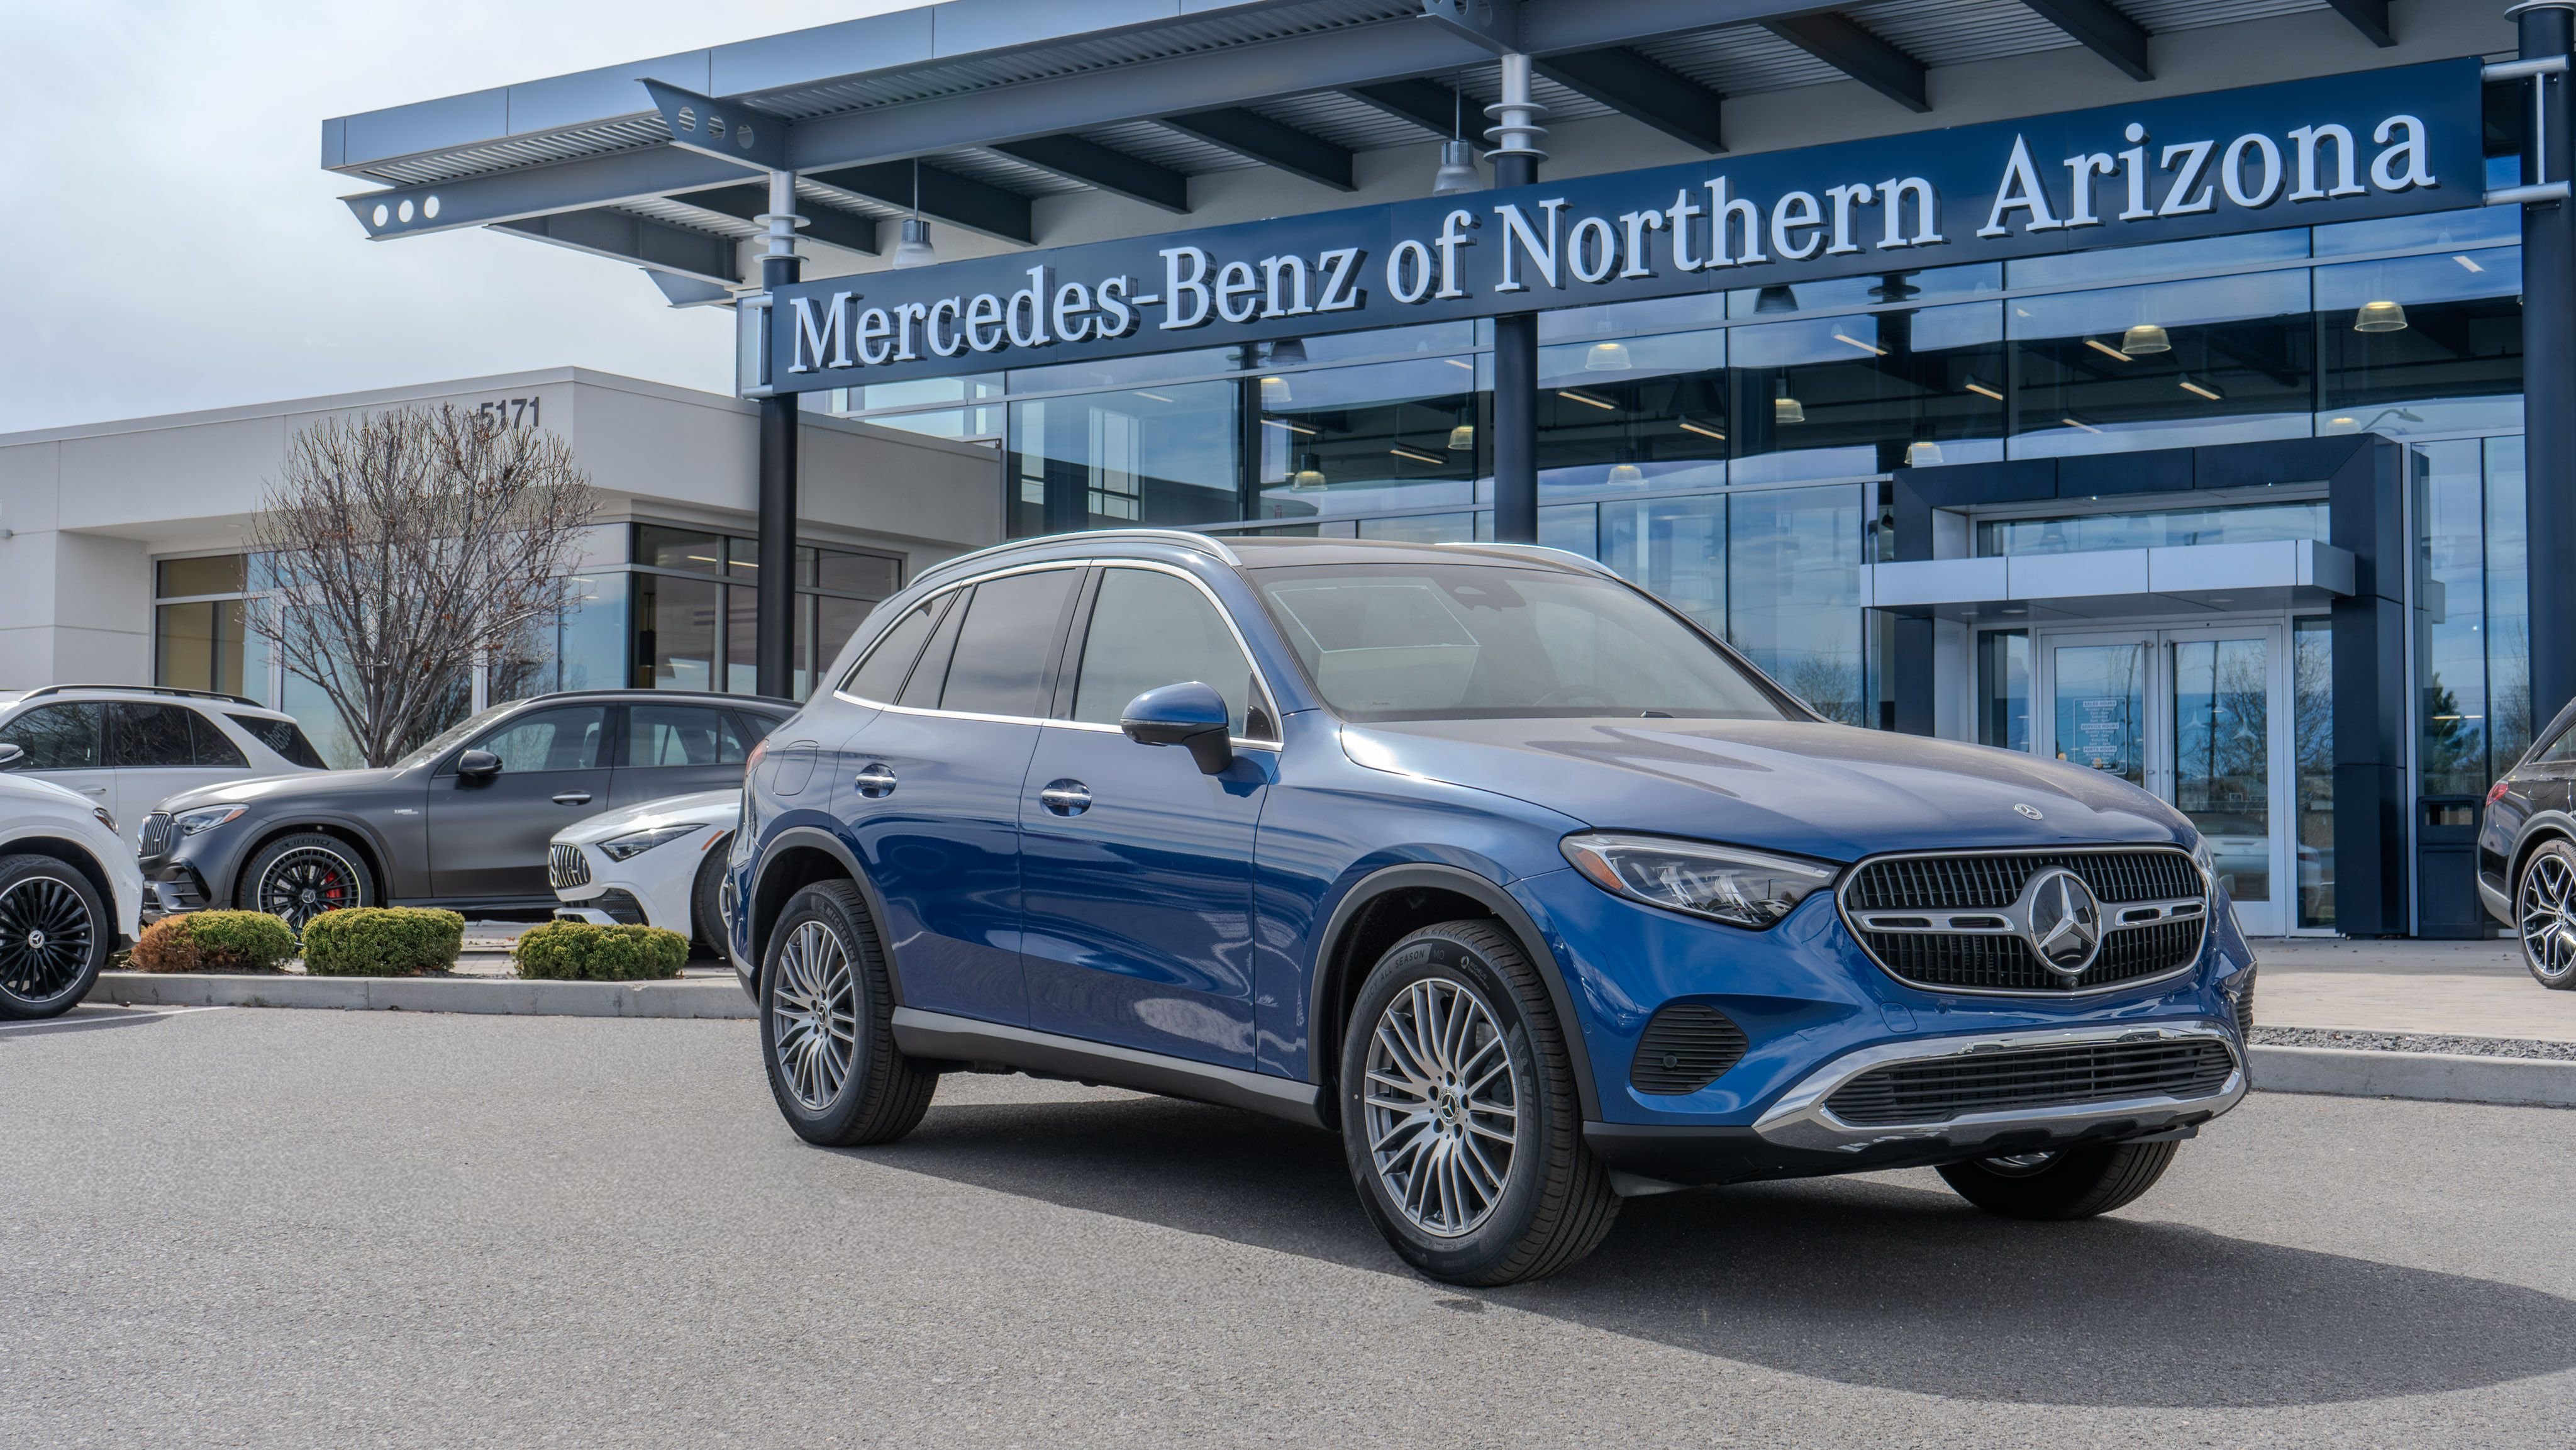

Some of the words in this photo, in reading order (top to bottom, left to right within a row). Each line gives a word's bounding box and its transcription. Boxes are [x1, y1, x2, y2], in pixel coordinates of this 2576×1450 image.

[788, 246, 1362, 374] Mercedes-Benz
[1387, 209, 1475, 304] of
[1494, 176, 1946, 293] Northern
[1976, 114, 2438, 238] Arizona
[480, 396, 540, 433] 5171
[825, 907, 855, 960] MICHELIN
[1355, 981, 1378, 1022] PRIMACY
[1380, 966, 1392, 982] ALL
[1395, 949, 1424, 969] SEASON
